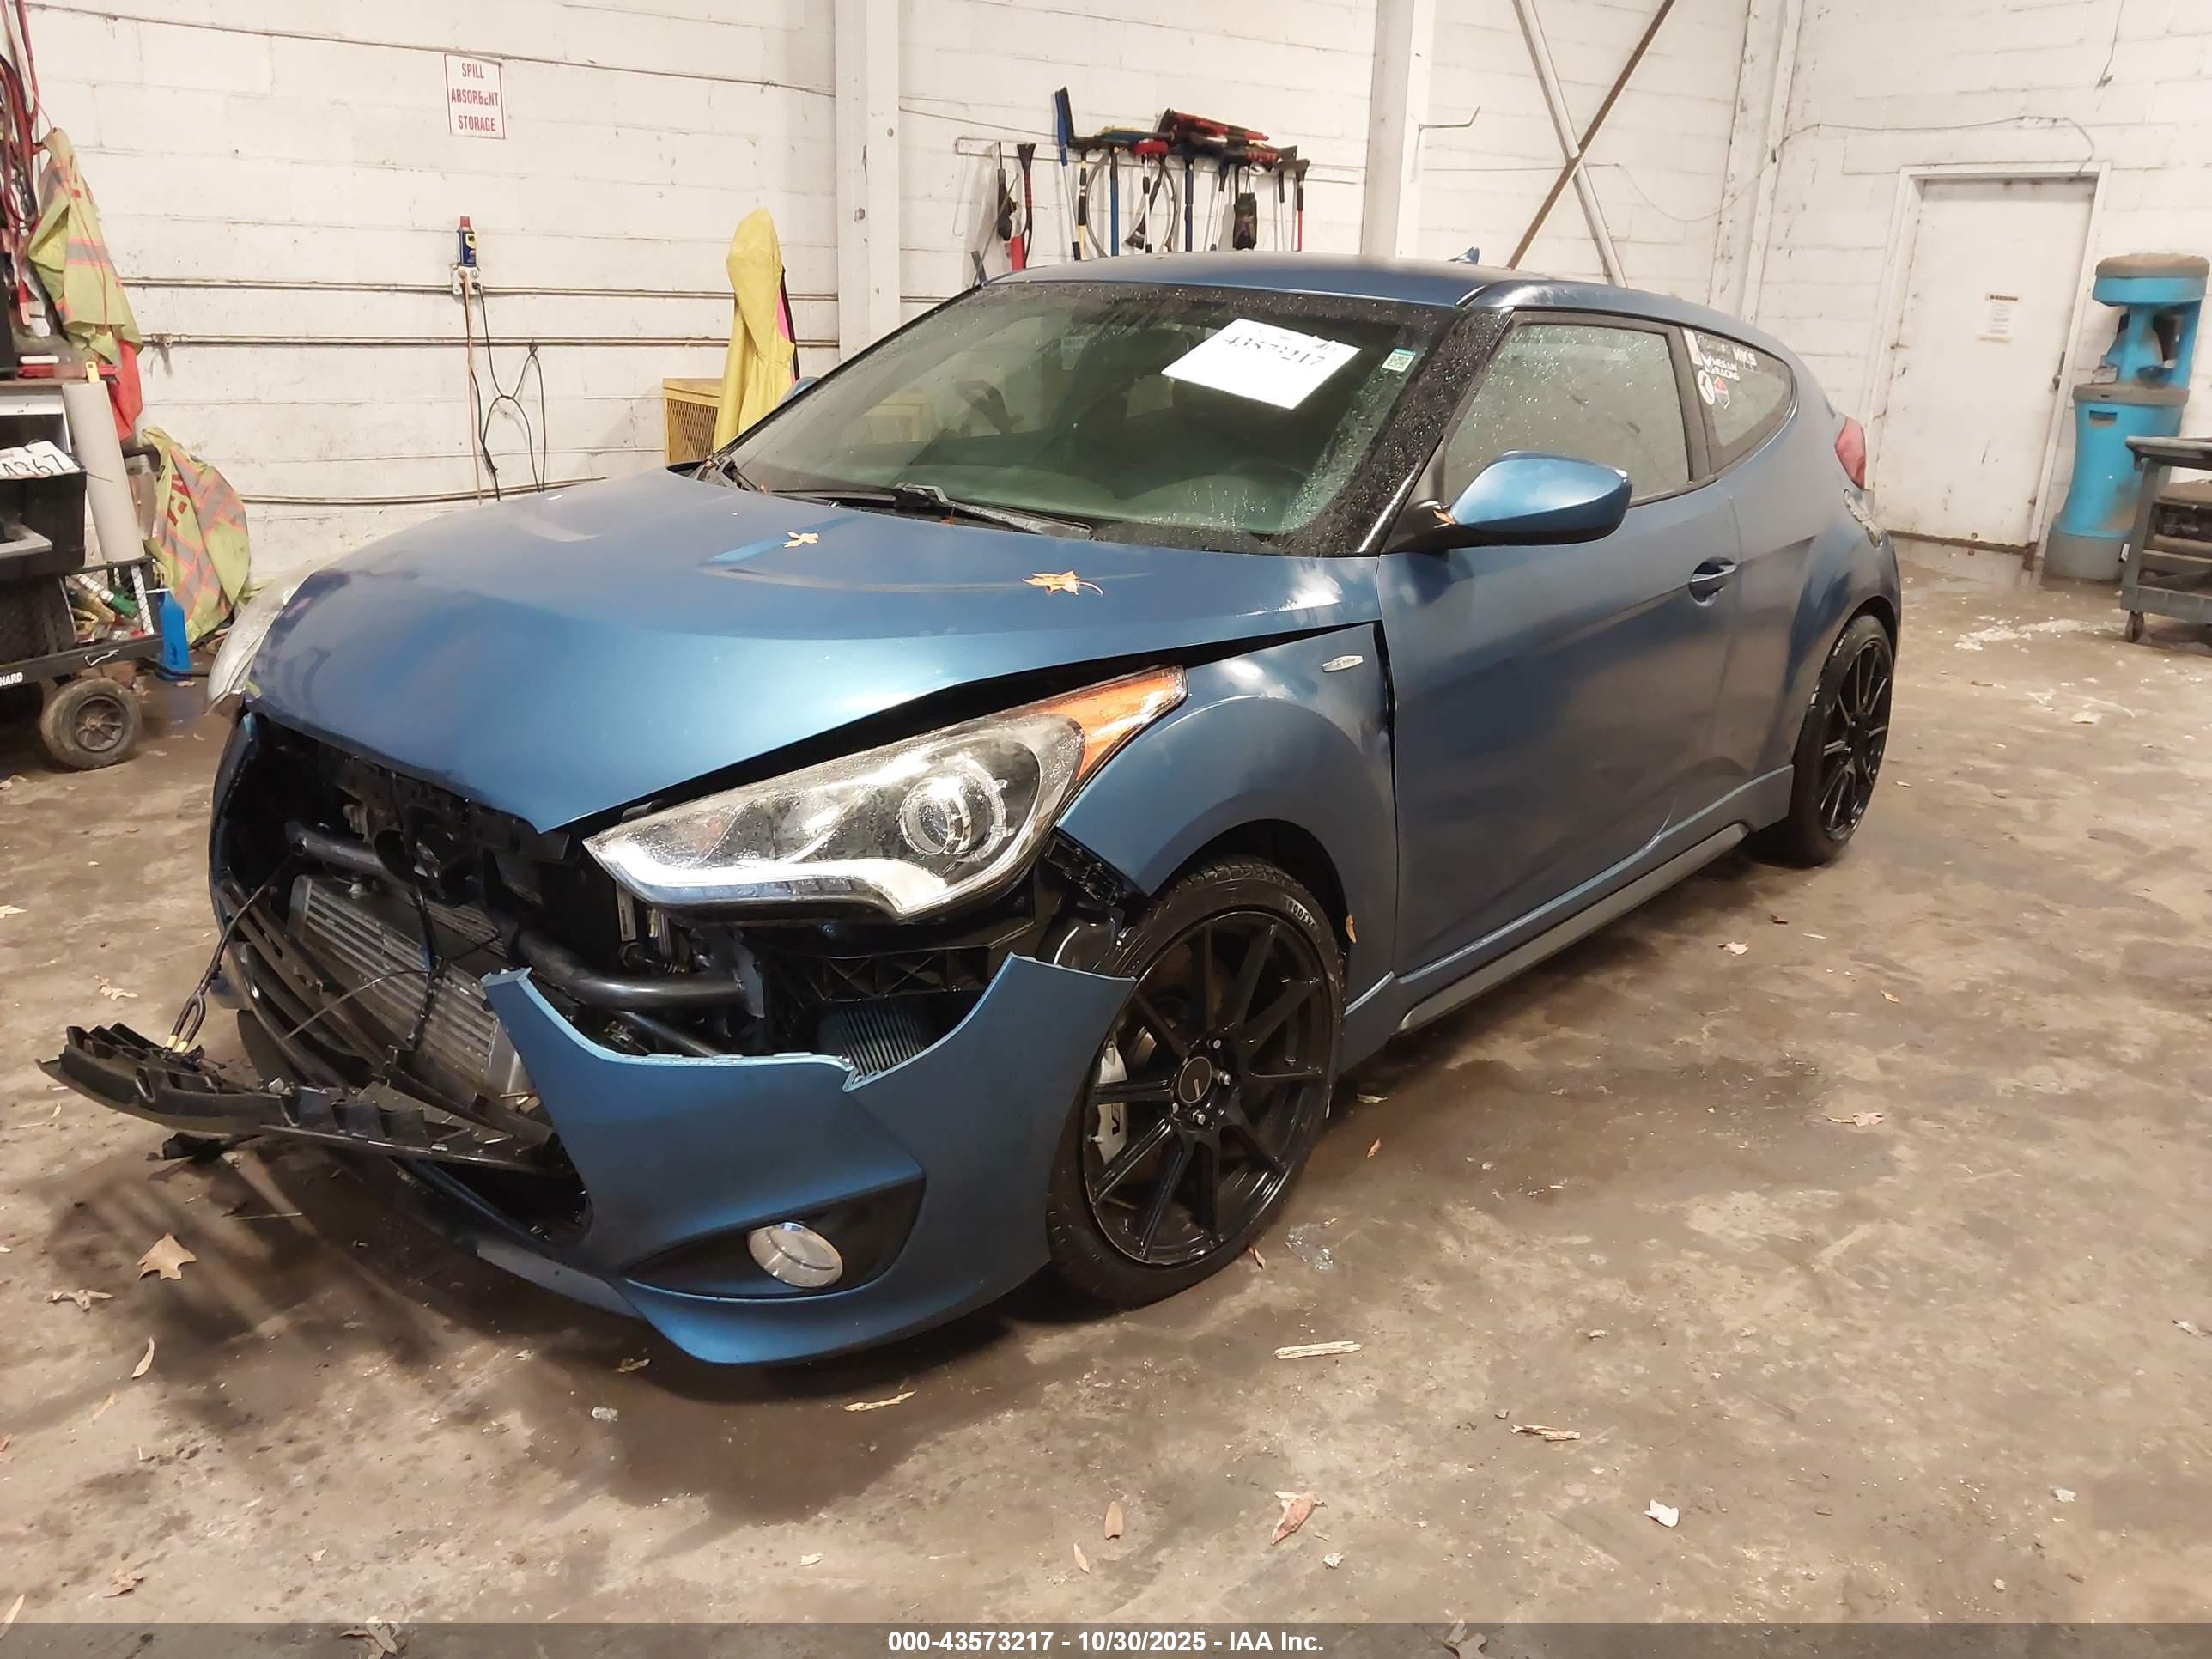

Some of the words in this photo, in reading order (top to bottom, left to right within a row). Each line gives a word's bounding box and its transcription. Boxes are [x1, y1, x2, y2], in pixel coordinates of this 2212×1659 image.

[461, 62, 484, 80] SPILL
[451, 88, 499, 106] ABSORBENT
[458, 114, 495, 132] STORAGE
